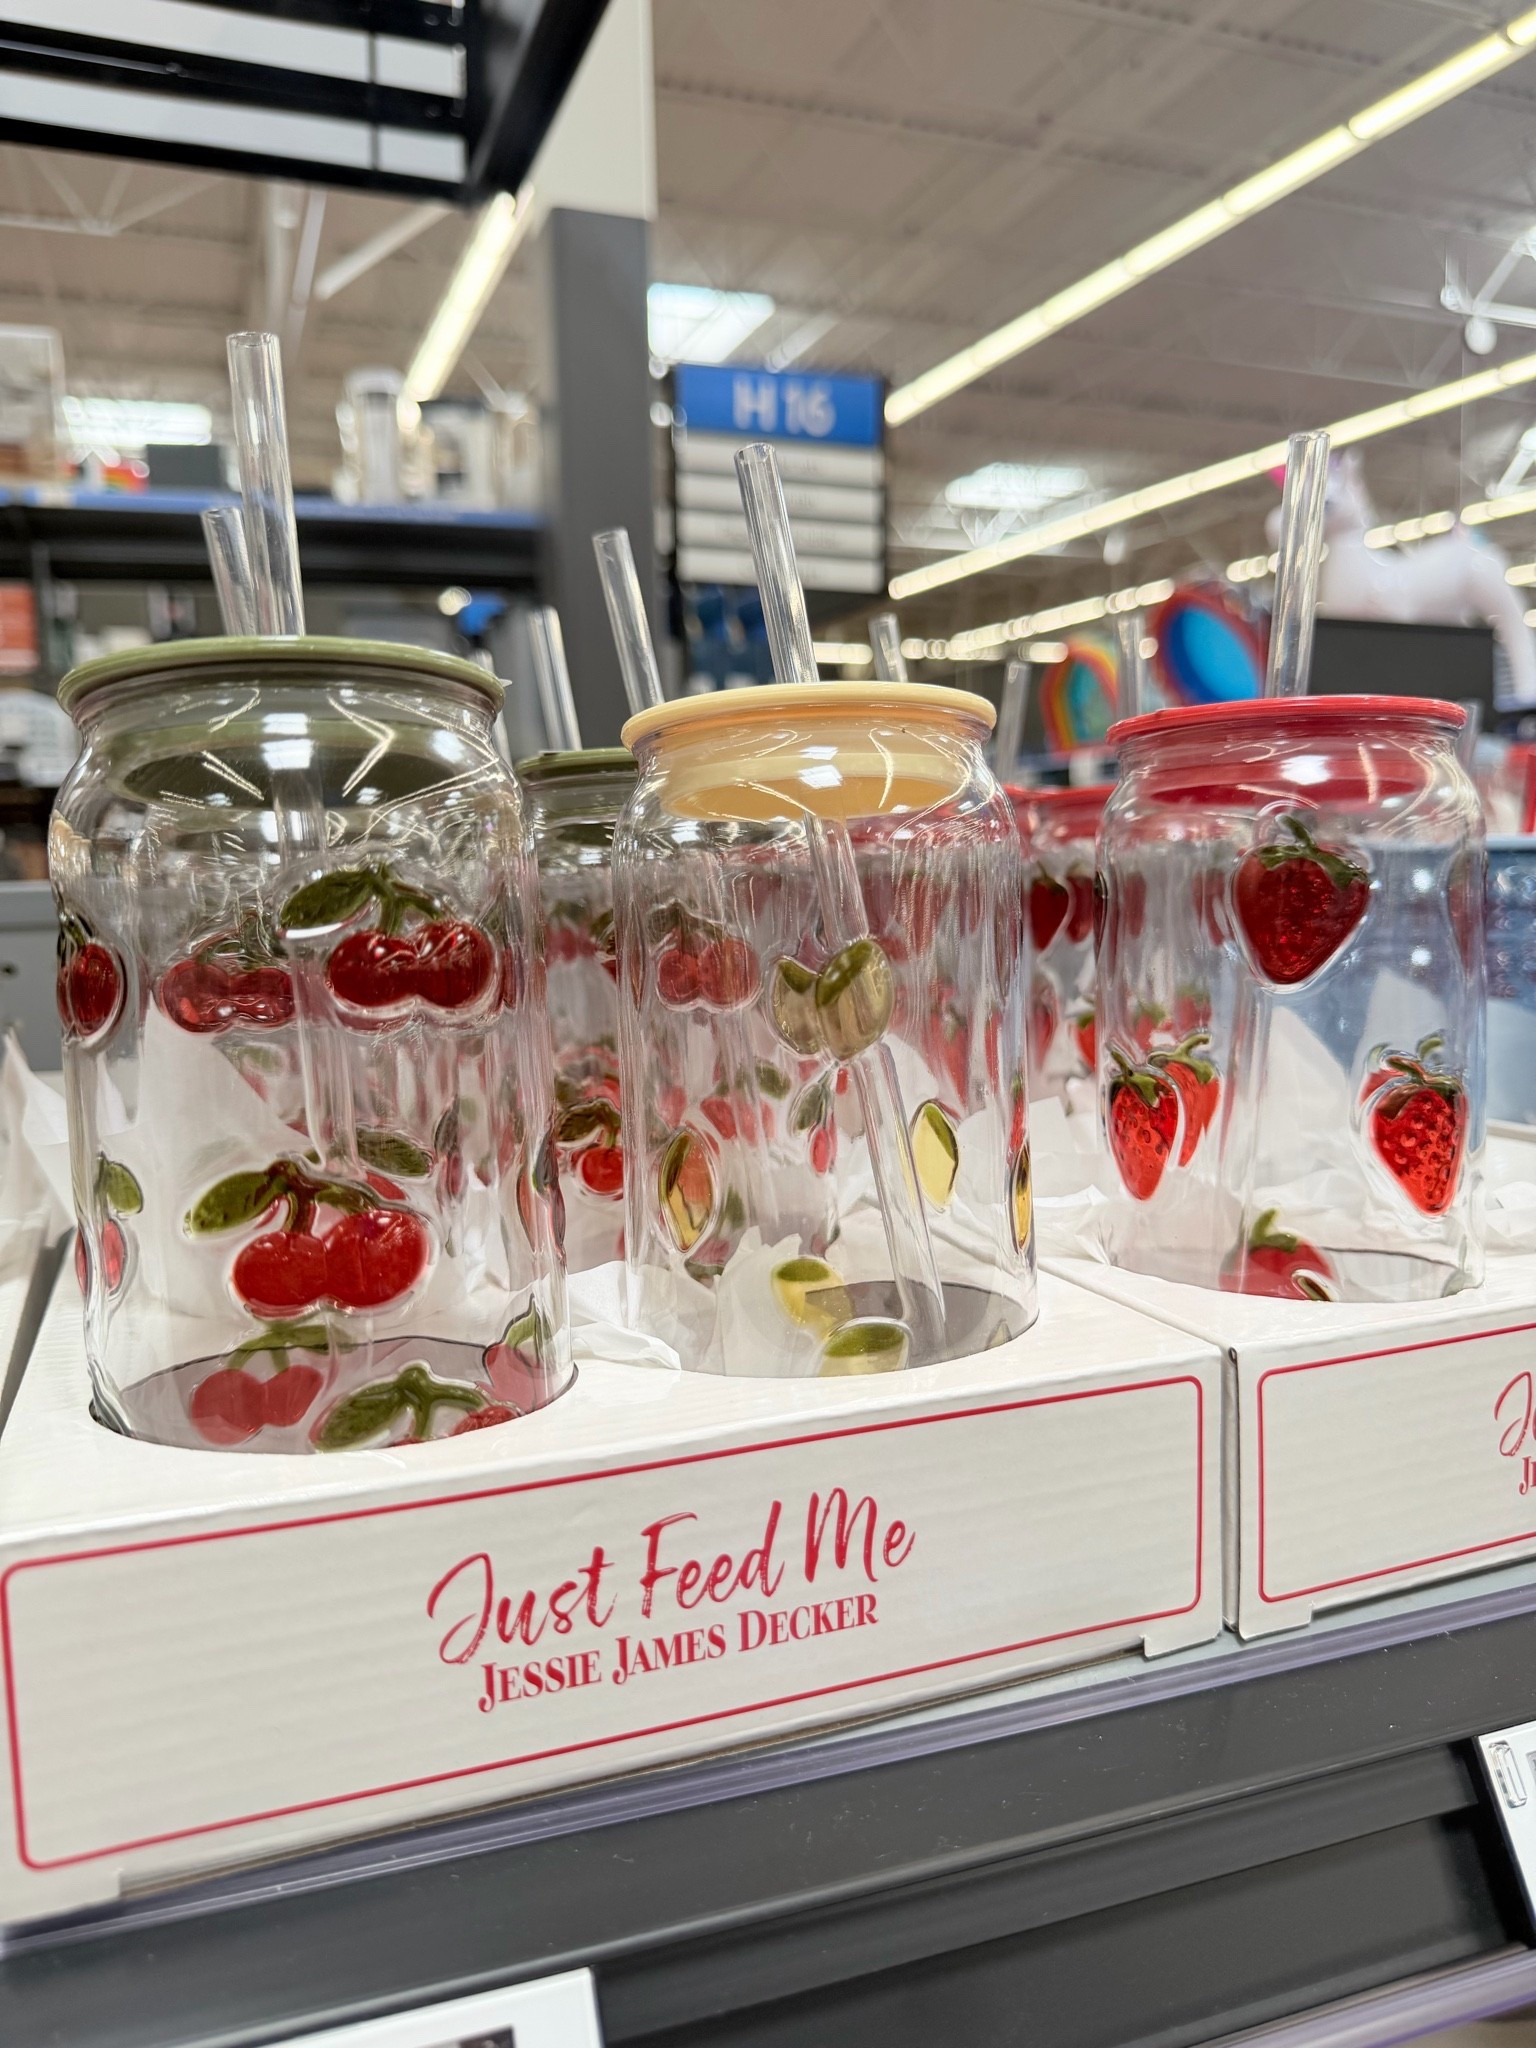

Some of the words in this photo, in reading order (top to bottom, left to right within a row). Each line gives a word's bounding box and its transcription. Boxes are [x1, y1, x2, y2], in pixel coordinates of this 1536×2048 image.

[427, 1546, 617, 1664] Just
[640, 1500, 785, 1618] Feed
[804, 1487, 915, 1583] Me
[478, 1650, 602, 1713] JESSIE
[612, 1623, 727, 1684] JAMES
[737, 1593, 879, 1653] DECKER
